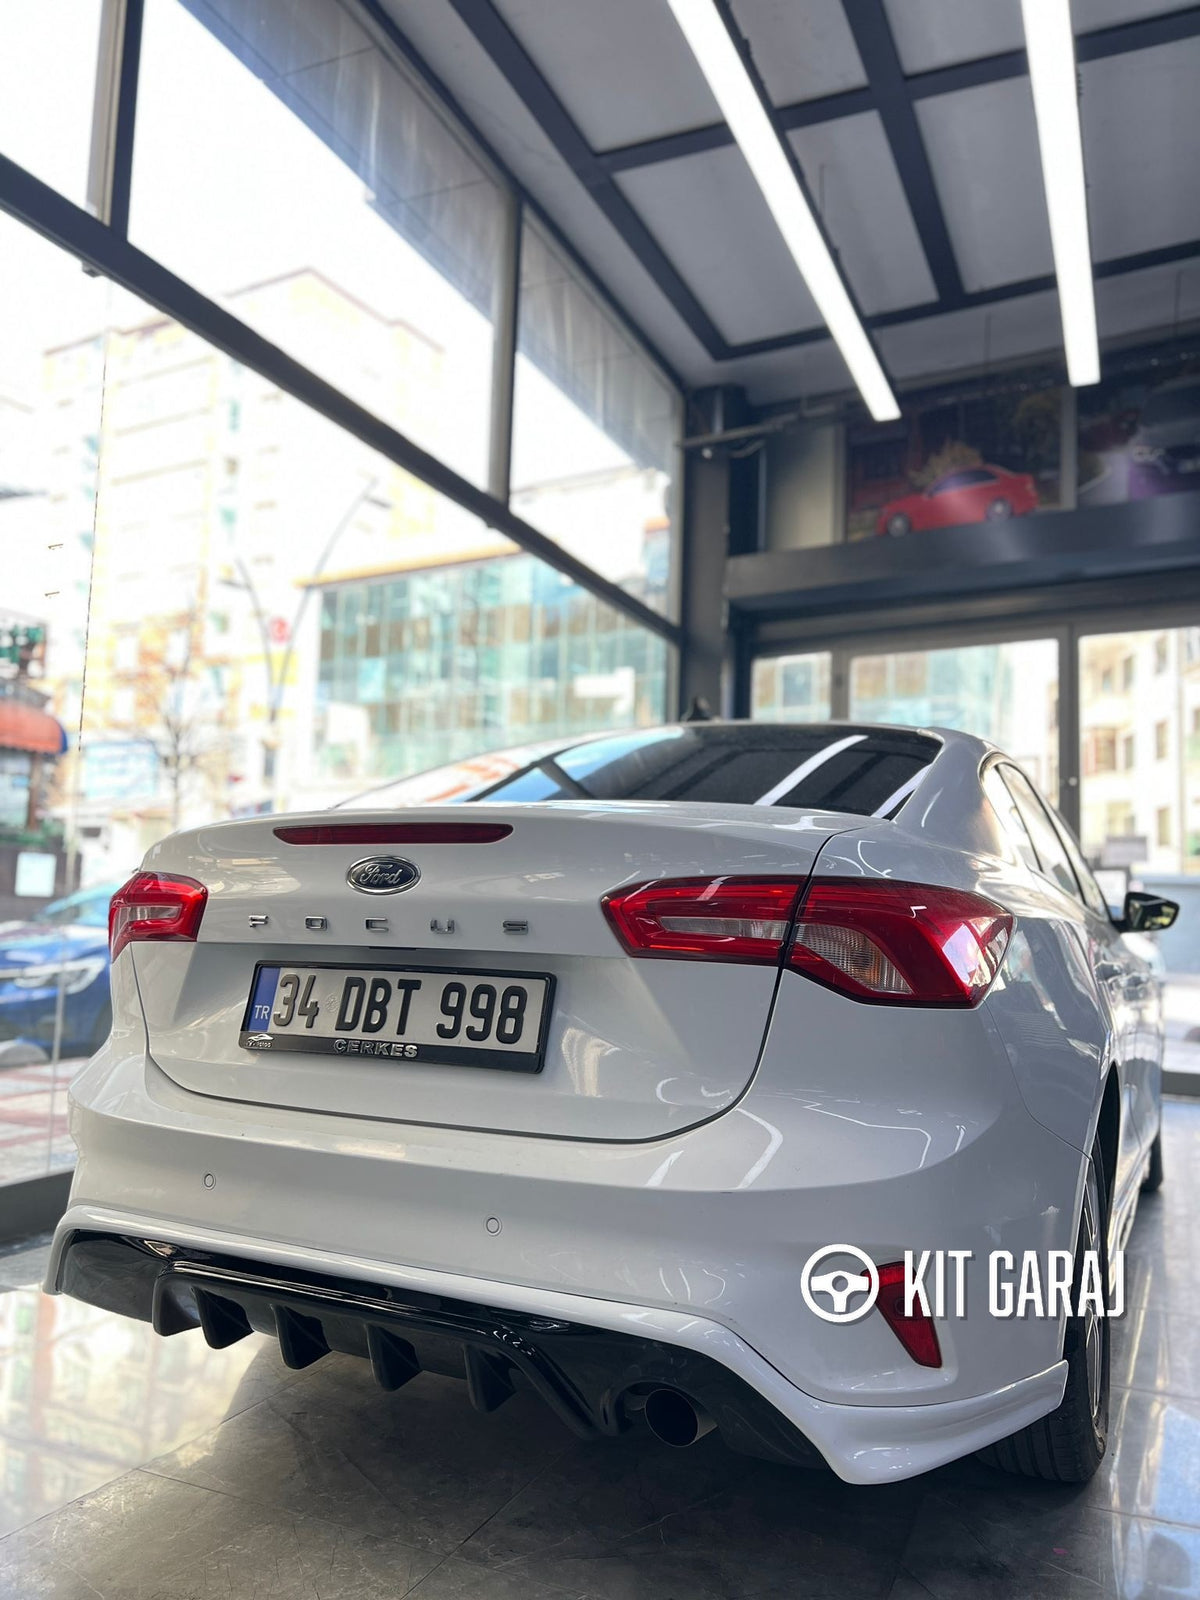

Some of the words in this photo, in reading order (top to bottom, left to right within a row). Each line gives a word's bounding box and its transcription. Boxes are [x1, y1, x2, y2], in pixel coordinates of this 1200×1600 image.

[360, 864, 402, 884] Ford
[249, 914, 529, 935] FOCUS
[254, 1004, 270, 1021] TR
[272, 974, 320, 1028] 34
[335, 976, 422, 1035] DBT
[436, 982, 528, 1044] 998
